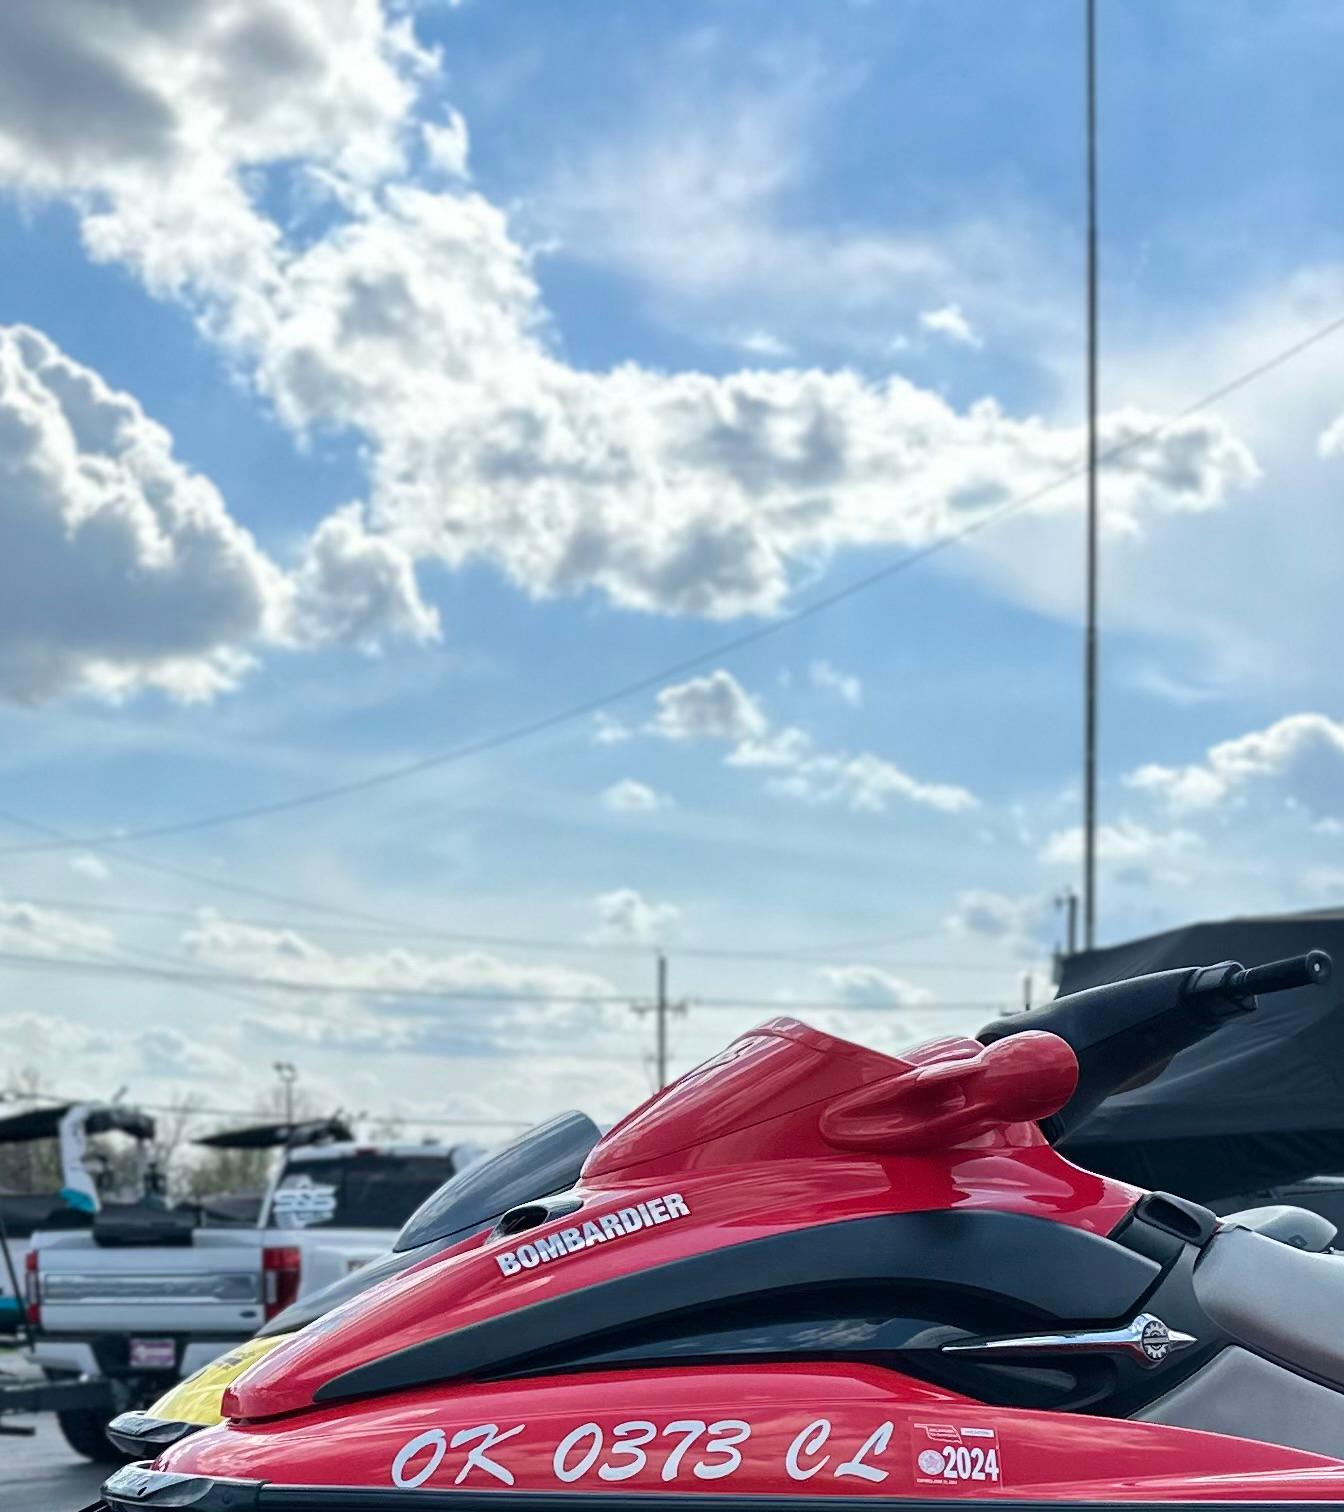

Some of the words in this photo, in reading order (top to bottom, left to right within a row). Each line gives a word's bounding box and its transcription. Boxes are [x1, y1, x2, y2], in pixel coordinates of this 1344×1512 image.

[495, 1193, 691, 1277] BOMBARDIER
[392, 1424, 525, 1489] OK
[553, 1420, 751, 1483] 0373
[942, 1445, 1000, 1482] 2024
